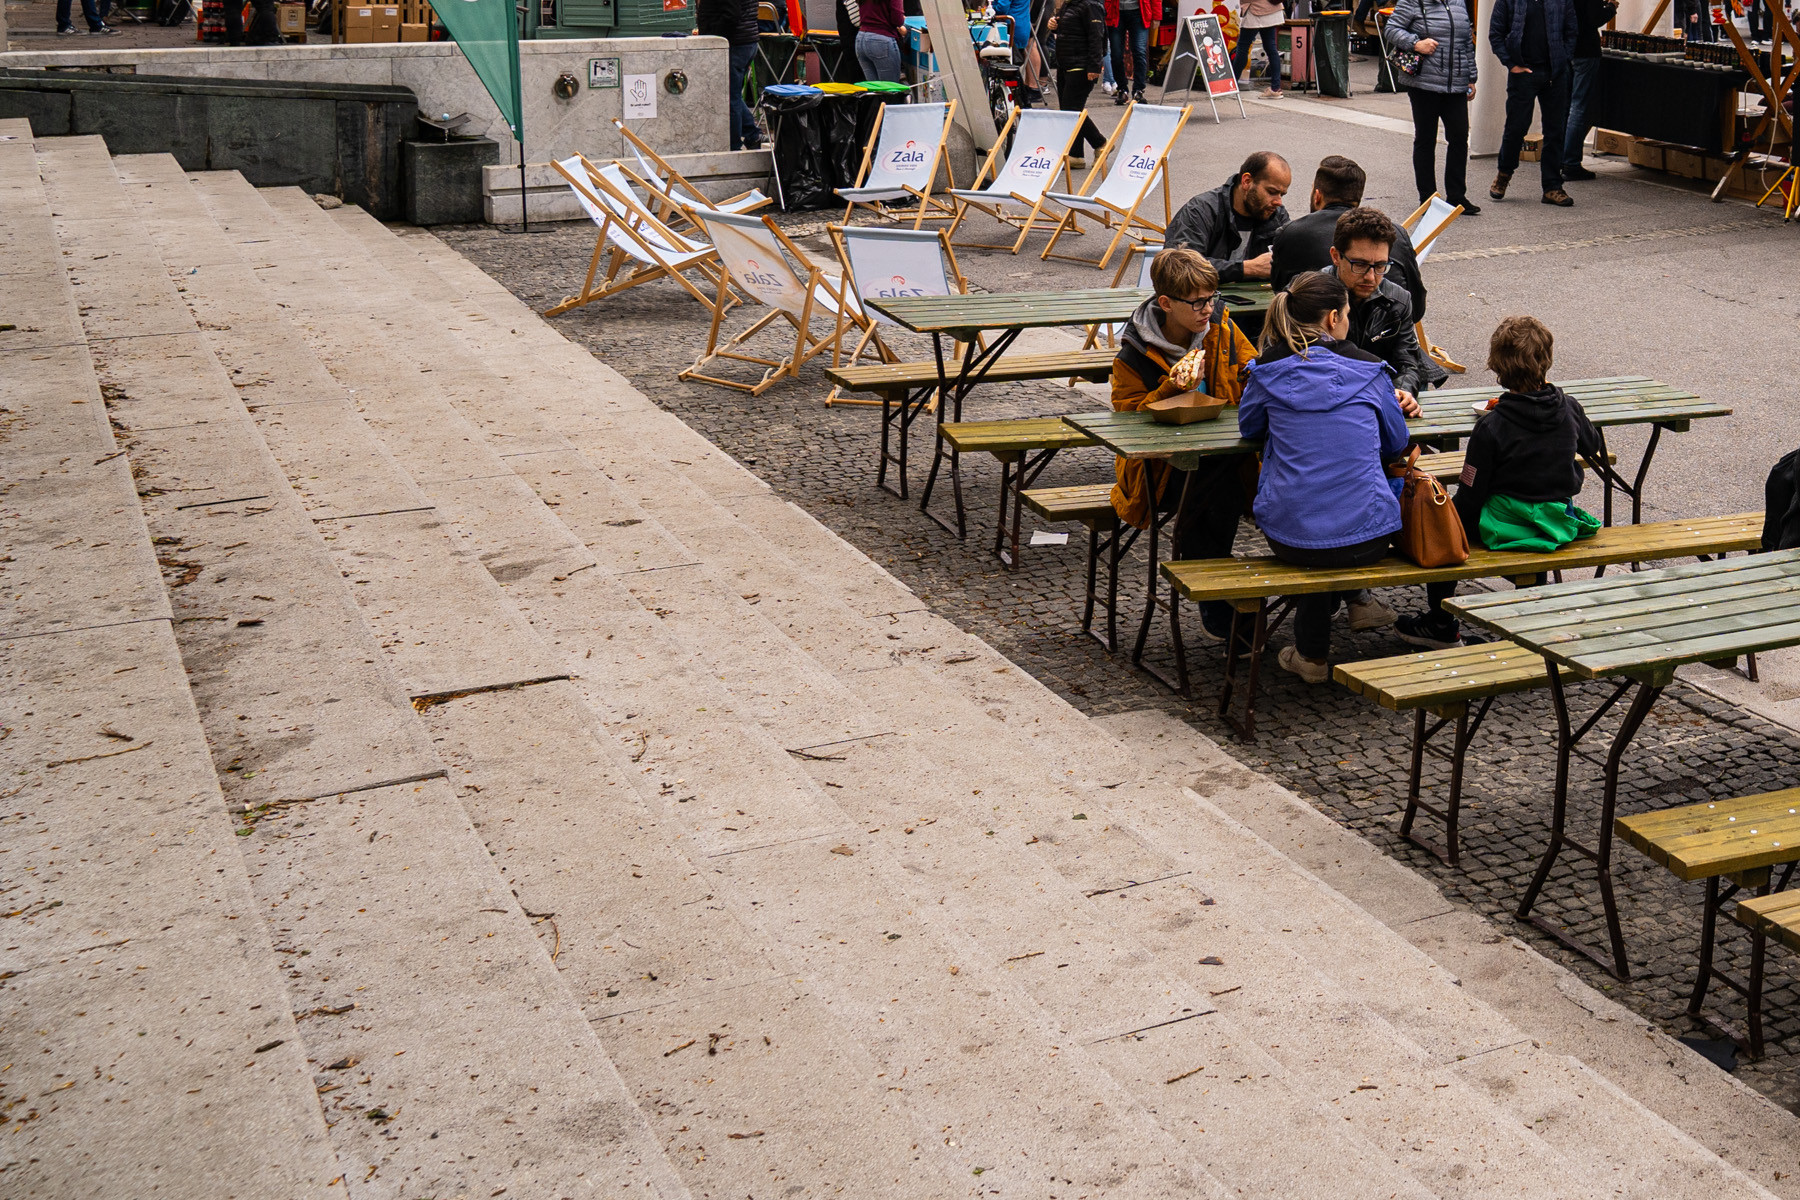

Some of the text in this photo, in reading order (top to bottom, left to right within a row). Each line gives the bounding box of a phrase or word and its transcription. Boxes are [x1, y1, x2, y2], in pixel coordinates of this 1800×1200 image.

[1296, 36, 1303, 49] 5
[891, 151, 924, 163] Zala
[1019, 156, 1051, 170] Zala
[1127, 155, 1156, 170] Zala
